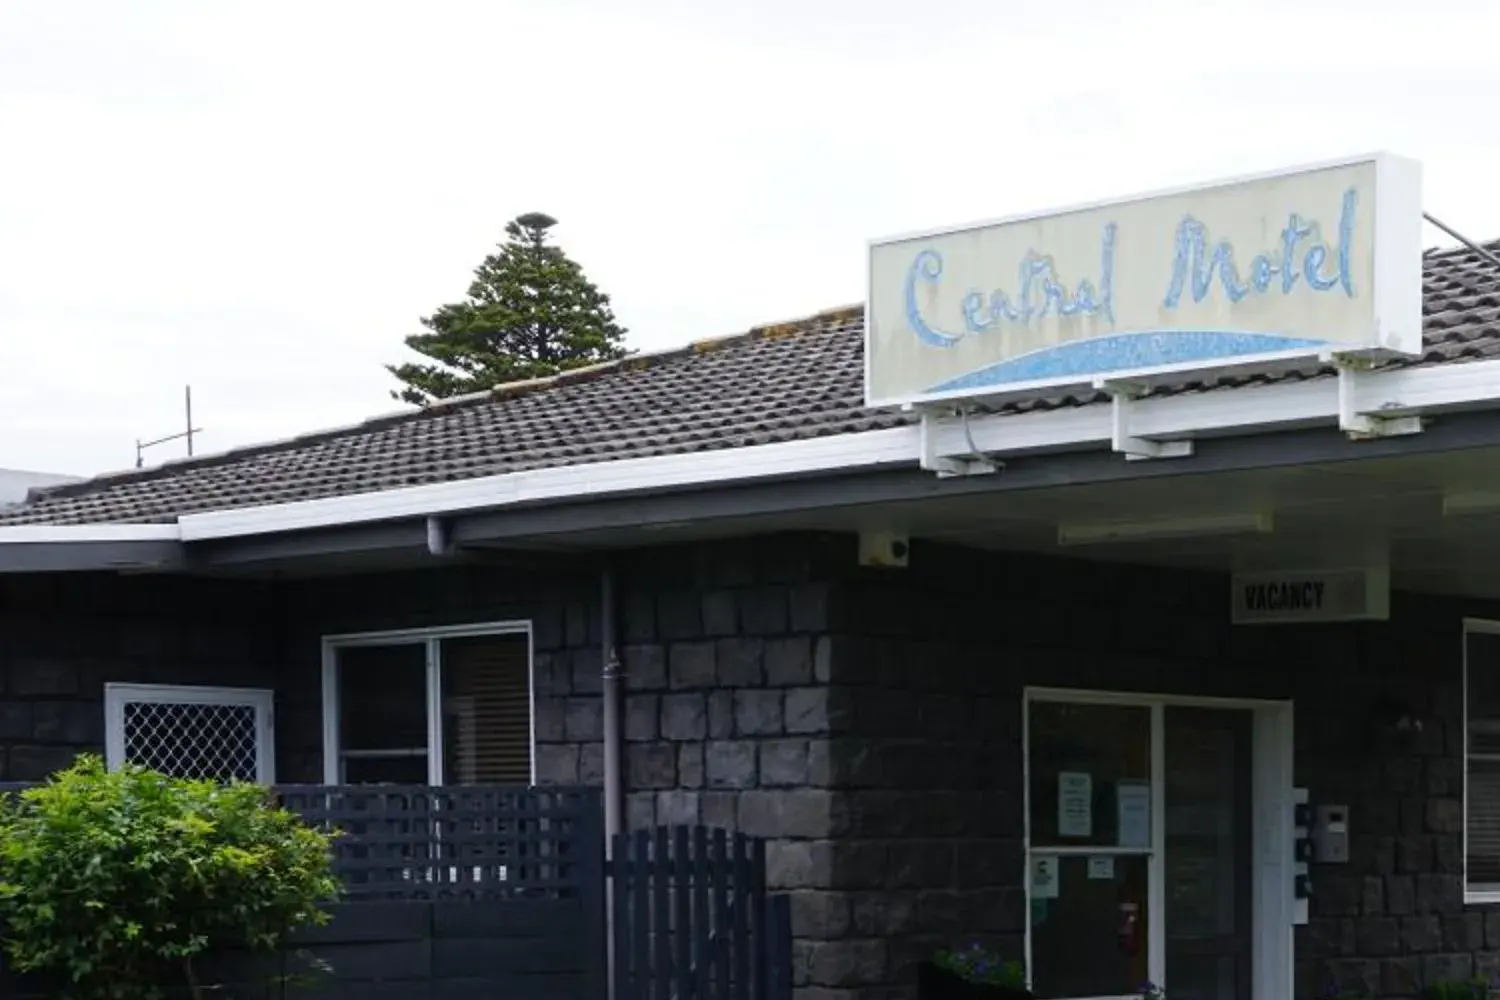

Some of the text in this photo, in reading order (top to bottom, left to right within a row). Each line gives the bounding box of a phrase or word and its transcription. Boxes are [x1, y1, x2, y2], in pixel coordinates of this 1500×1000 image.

[904, 187, 1358, 348] Central Motel
[1245, 580, 1324, 610] VACANCY
